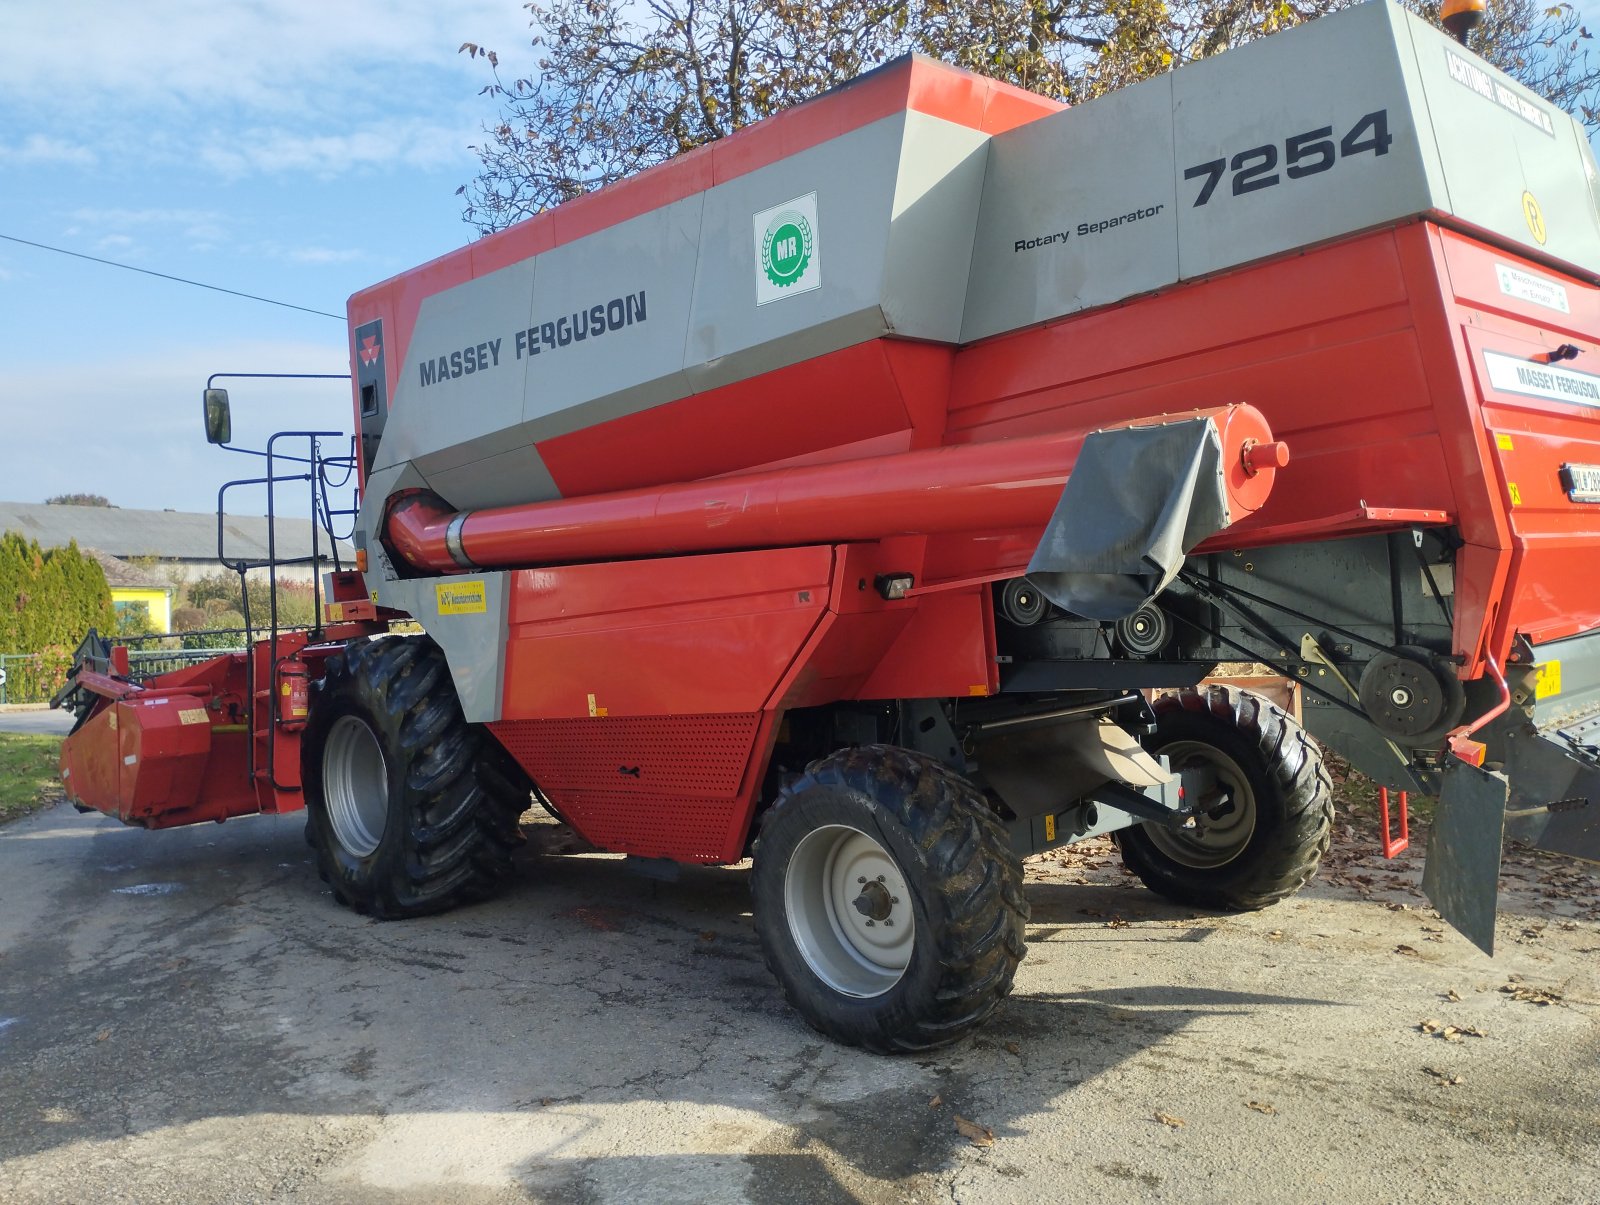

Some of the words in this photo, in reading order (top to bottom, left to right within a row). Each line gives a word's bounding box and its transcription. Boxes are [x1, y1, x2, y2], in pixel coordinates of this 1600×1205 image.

[1184, 109, 1393, 208] 7254
[776, 236, 797, 262] MR
[1014, 229, 1070, 253] Rotary
[1077, 204, 1165, 235] Separator
[419, 337, 502, 388] MASSEY
[515, 290, 648, 360] FERGUSON
[1516, 367, 1556, 391] MASSEY
[1556, 375, 1600, 400] FERGUSON
